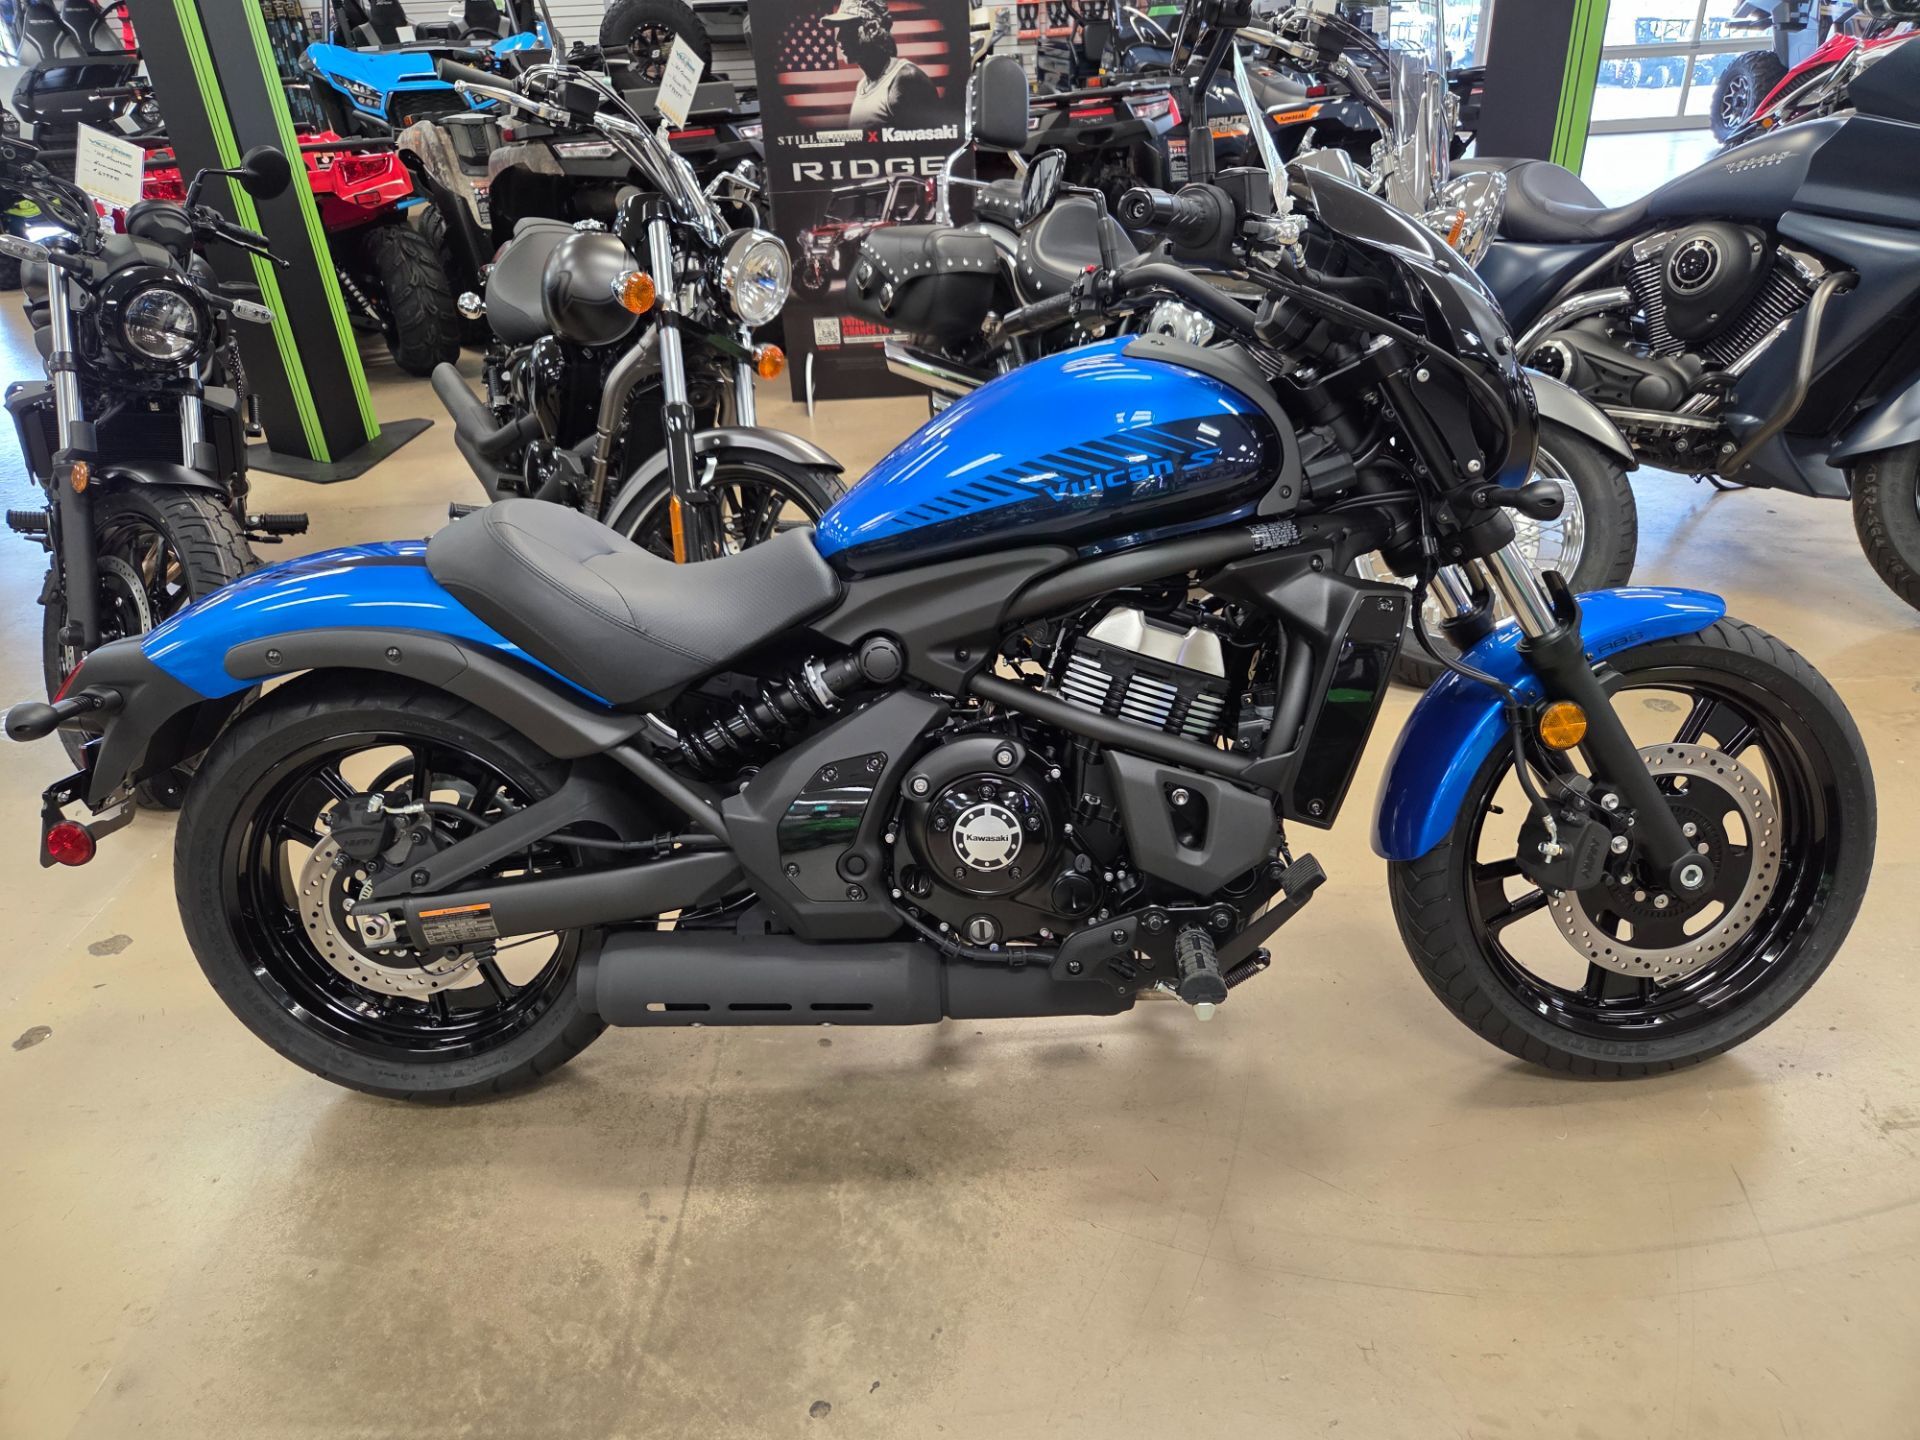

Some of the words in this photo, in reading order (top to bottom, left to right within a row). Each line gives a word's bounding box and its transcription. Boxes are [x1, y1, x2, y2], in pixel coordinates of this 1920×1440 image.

[777, 135, 817, 146] STILL
[882, 125, 958, 143] Kawasaki
[792, 155, 946, 182] RIDGE
[967, 834, 1008, 842] Kawasaki
